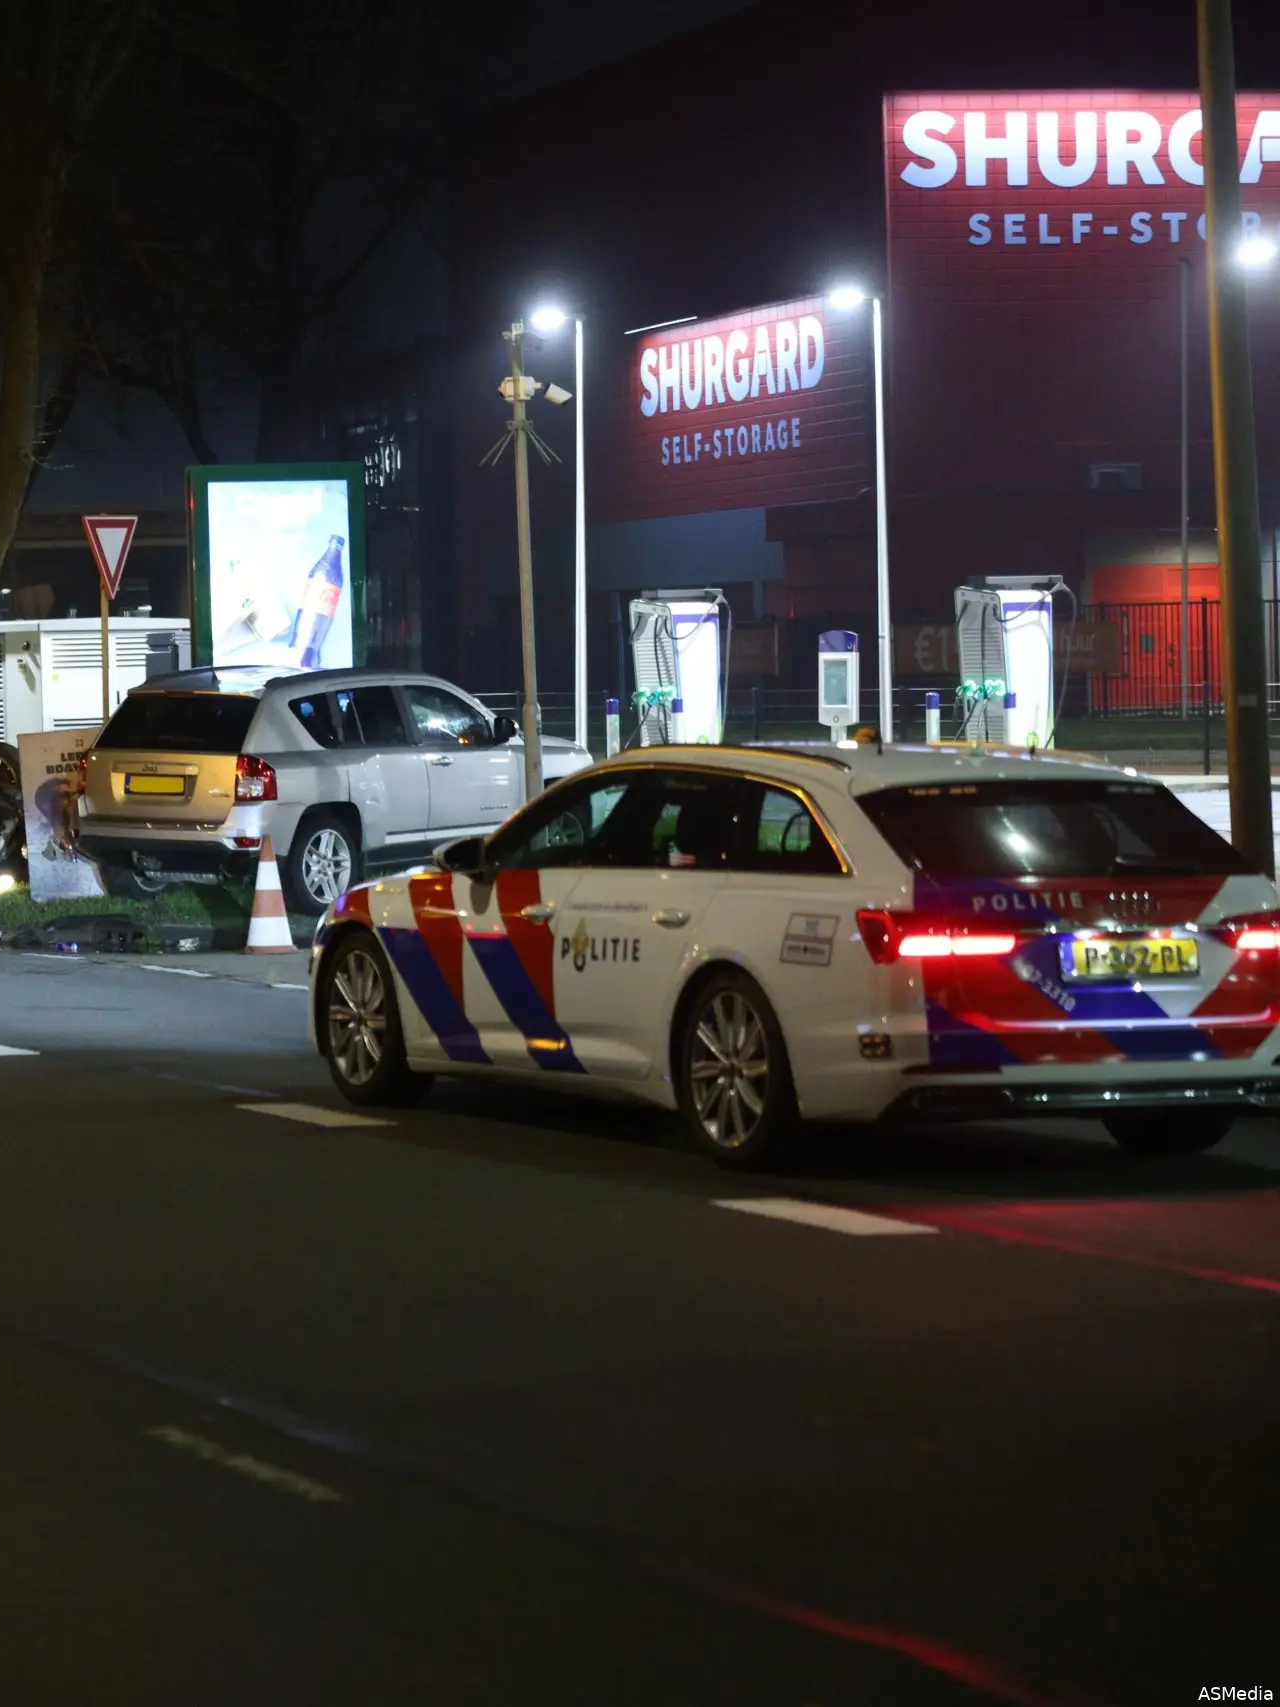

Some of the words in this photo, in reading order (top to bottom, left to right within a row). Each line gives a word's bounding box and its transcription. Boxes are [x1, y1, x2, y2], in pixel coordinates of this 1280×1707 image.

[639, 316, 825, 417] SHURGARD
[661, 417, 801, 466] SELF-STORAGE
[972, 891, 1084, 912] POLITIE
